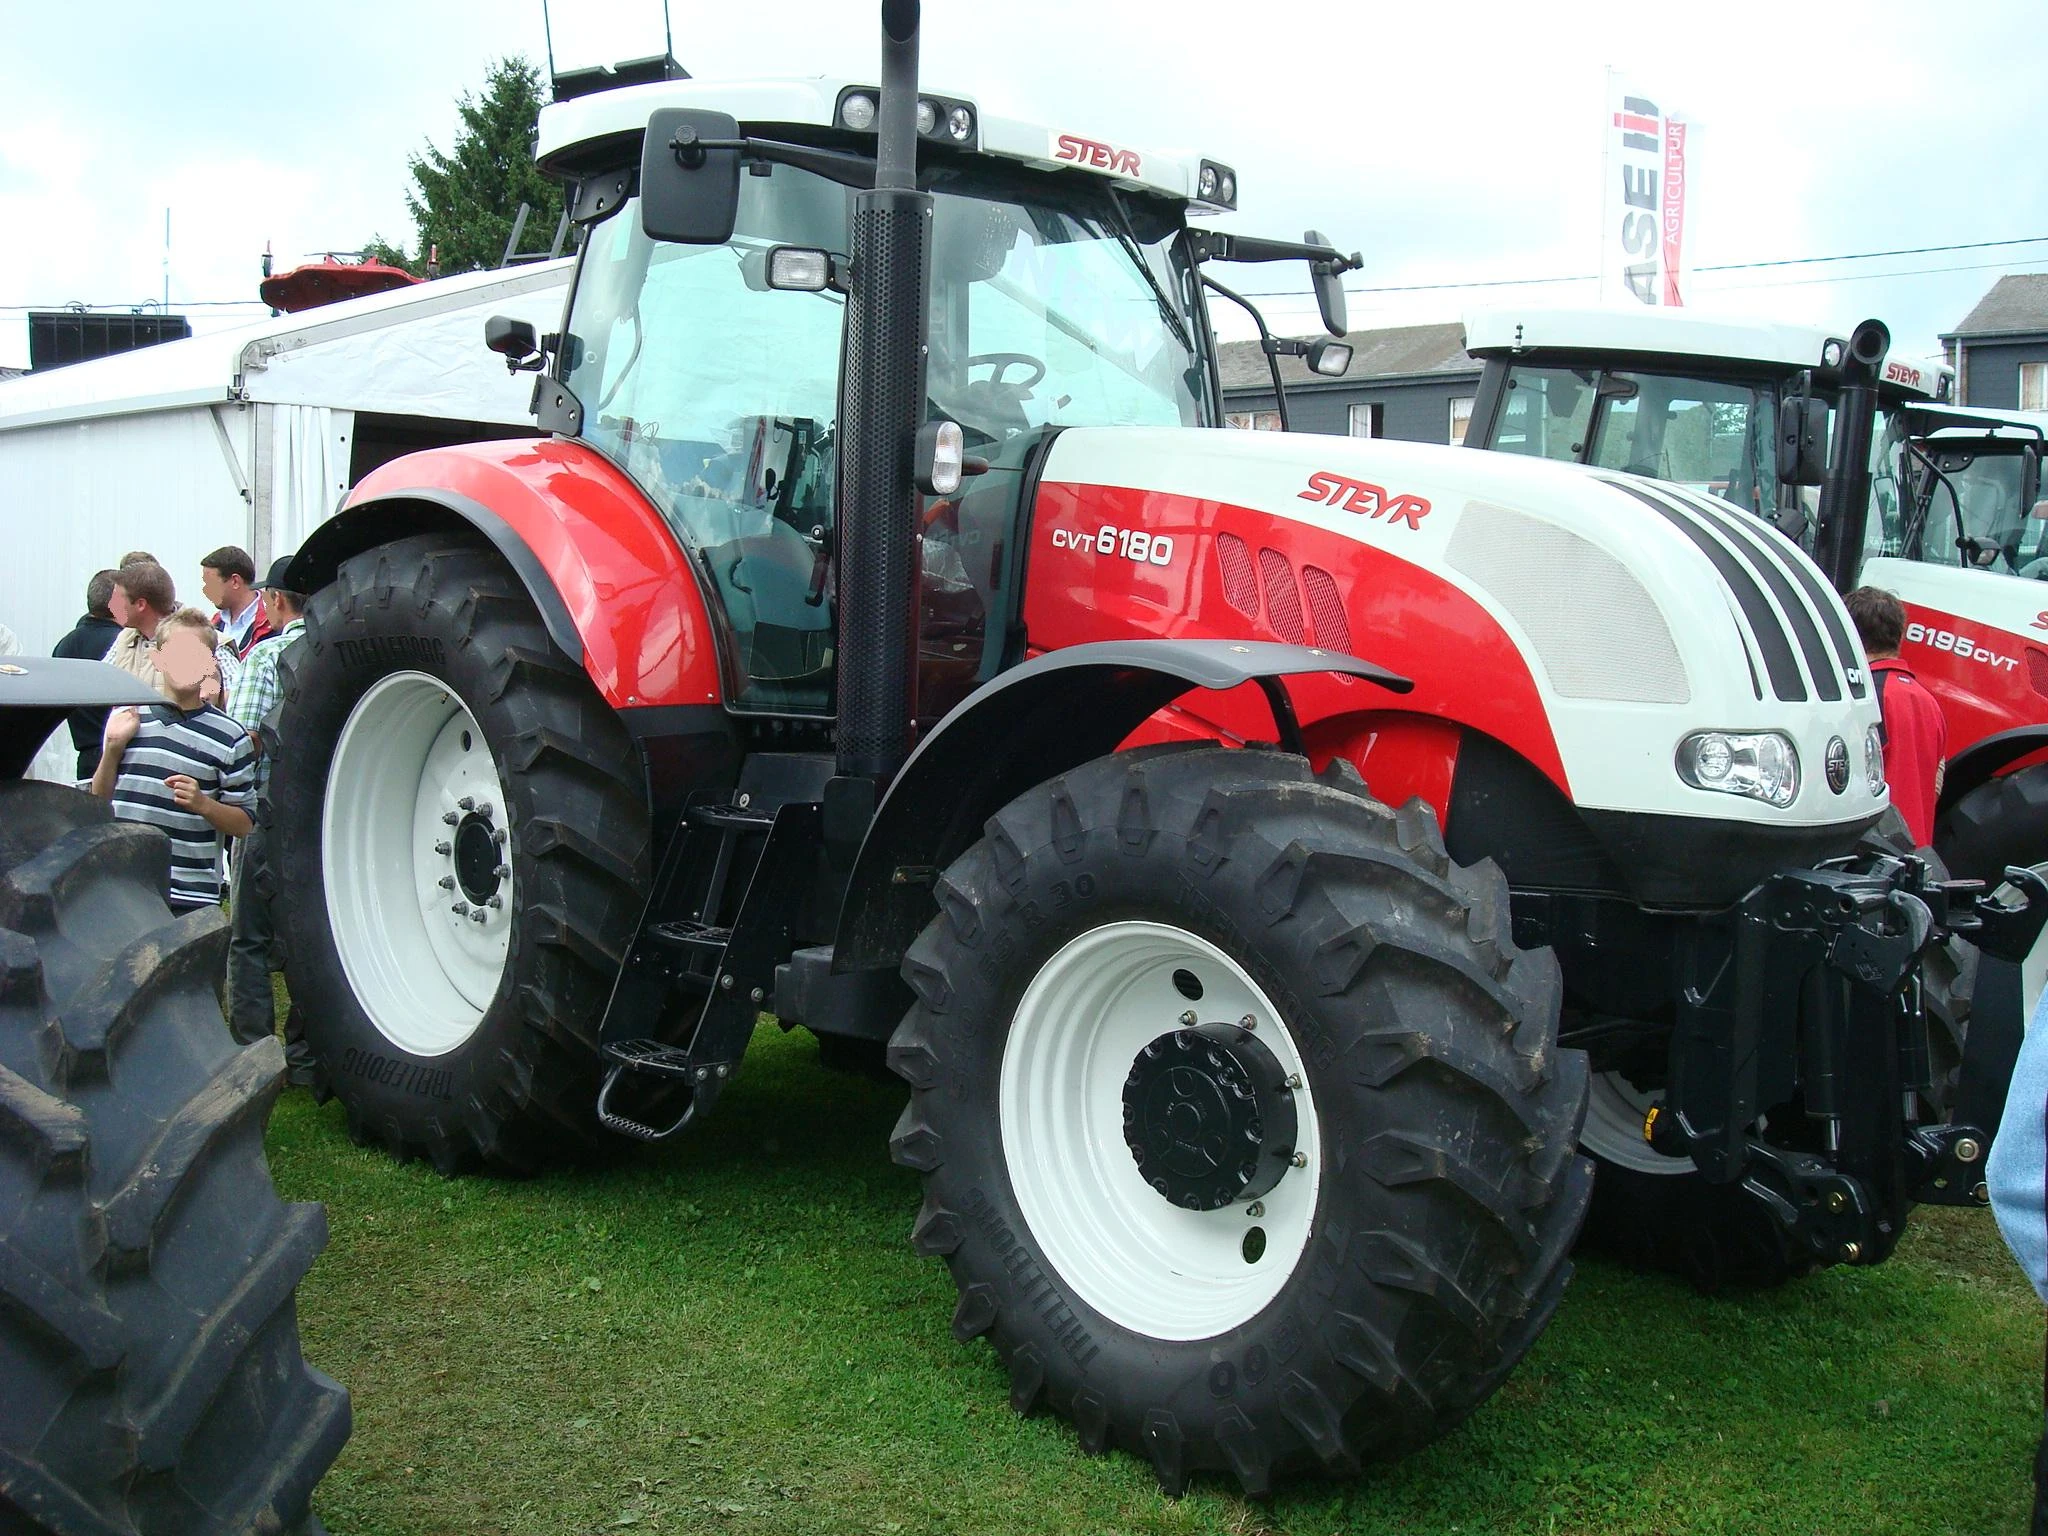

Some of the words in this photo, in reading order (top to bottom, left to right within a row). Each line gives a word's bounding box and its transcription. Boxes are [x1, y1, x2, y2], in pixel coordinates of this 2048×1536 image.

[1055, 134, 1141, 177] STEYR
[1886, 362, 1920, 387] STEYR
[1297, 470, 1431, 530] STEYR
